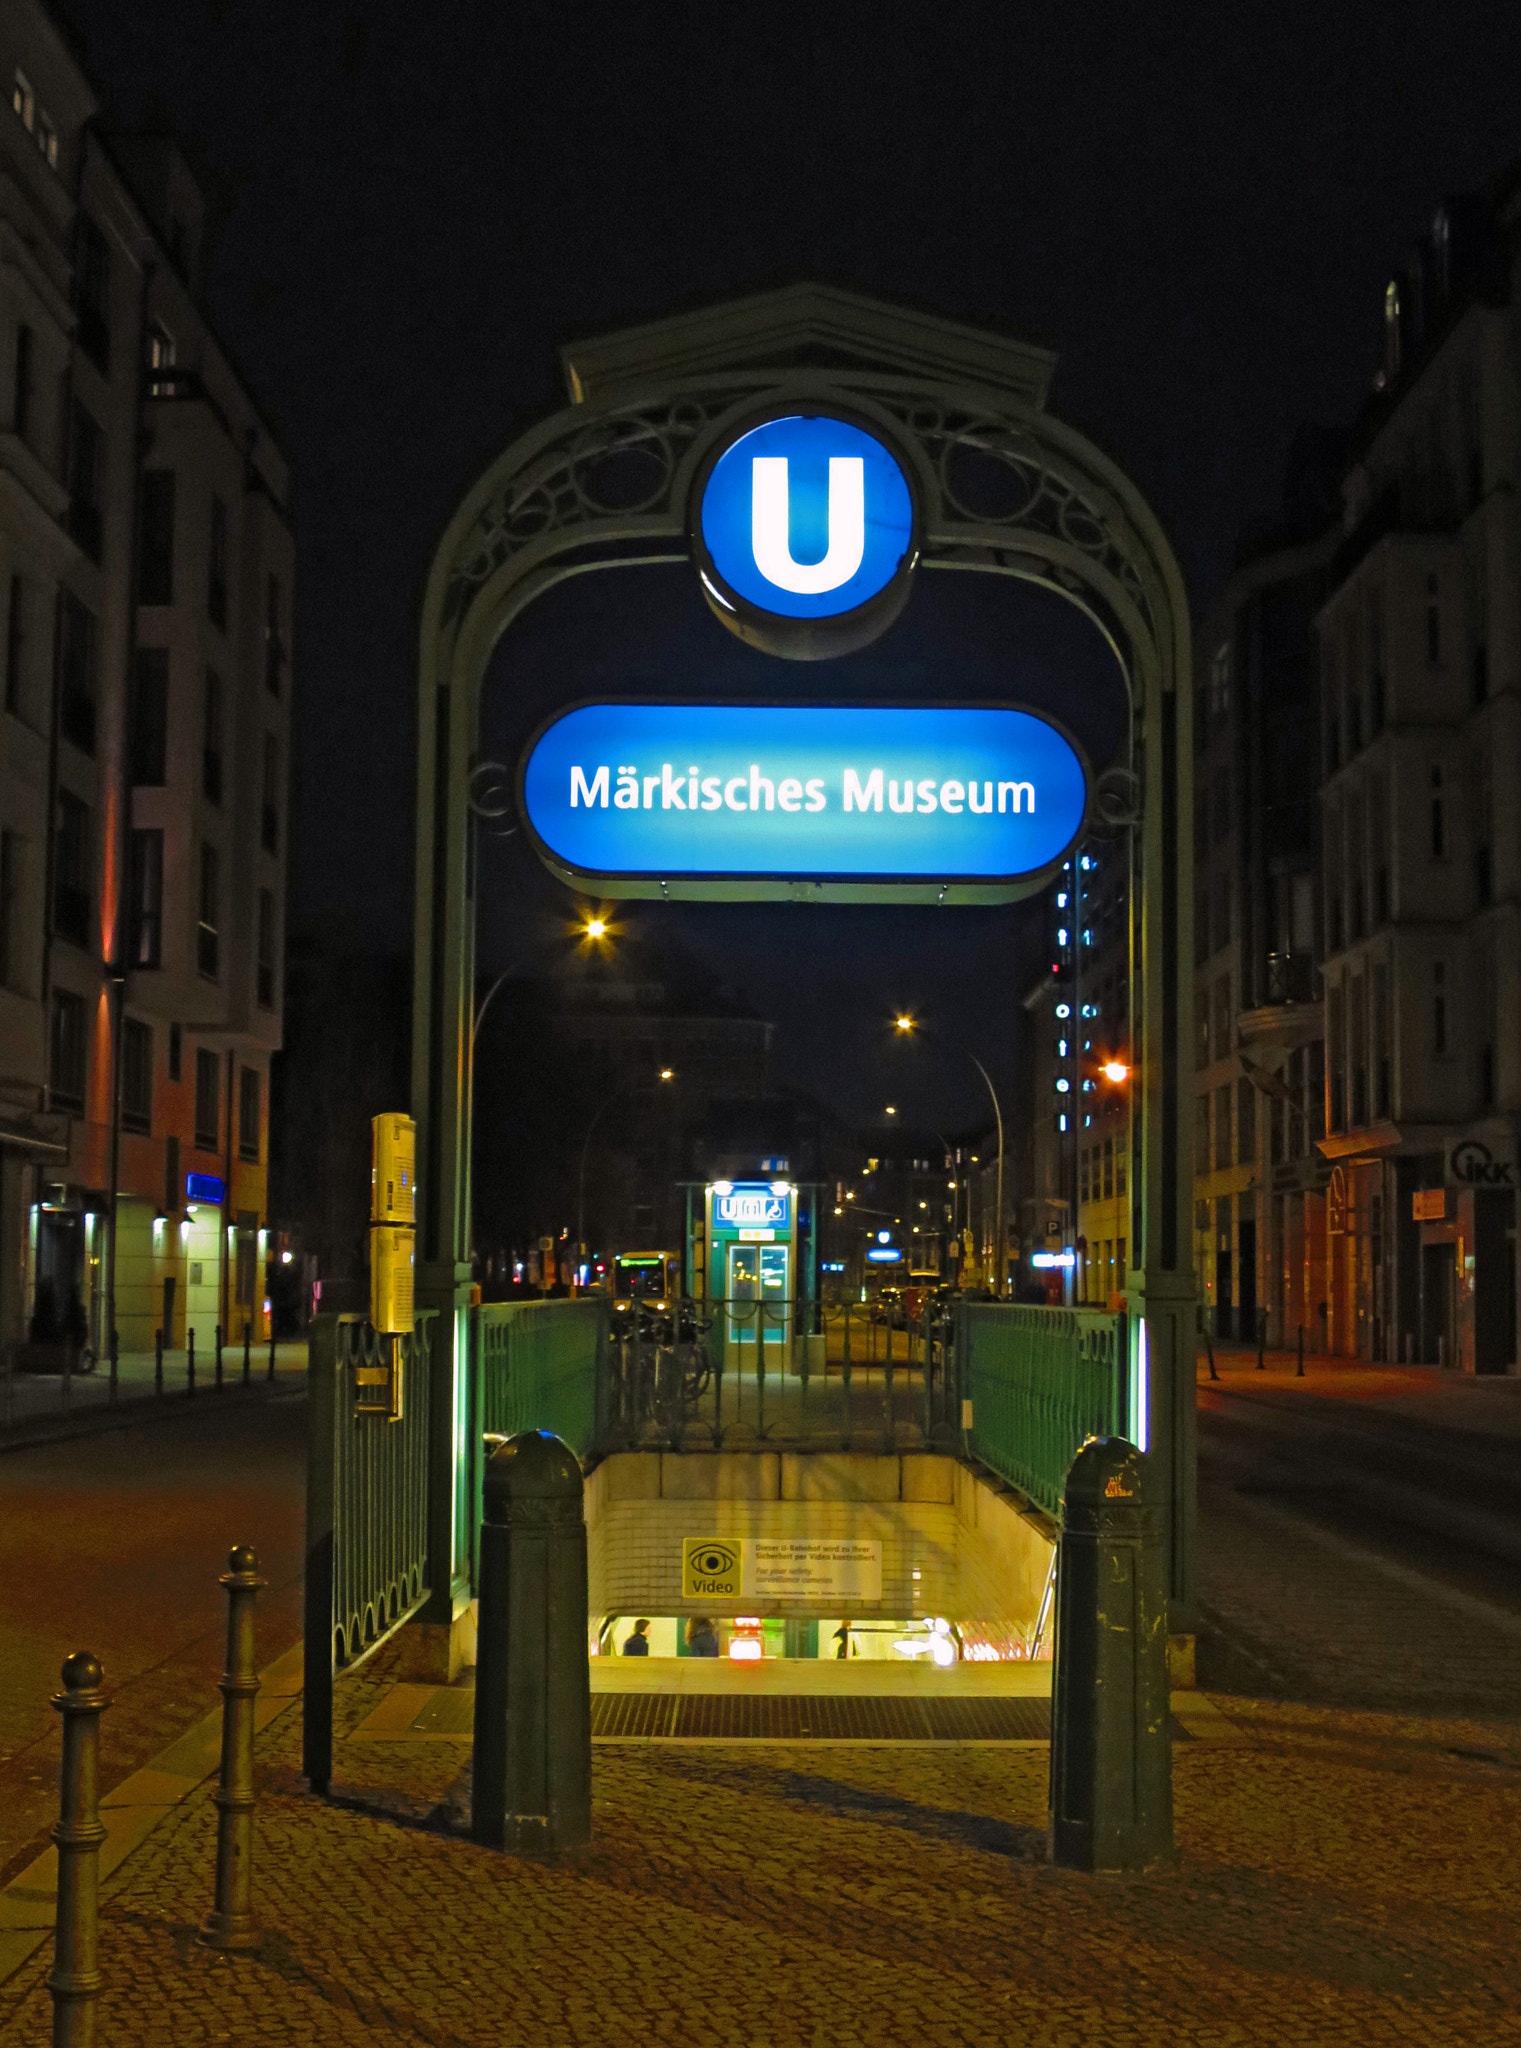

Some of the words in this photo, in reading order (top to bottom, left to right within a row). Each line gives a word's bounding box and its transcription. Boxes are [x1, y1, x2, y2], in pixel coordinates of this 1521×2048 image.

[751, 457, 864, 594] U
[570, 764, 826, 812] Märkisches
[843, 769, 1035, 814] Museum
[1048, 1222, 1058, 1234] P
[809, 1553, 831, 1561] Video
[692, 1579, 733, 1594] Video
